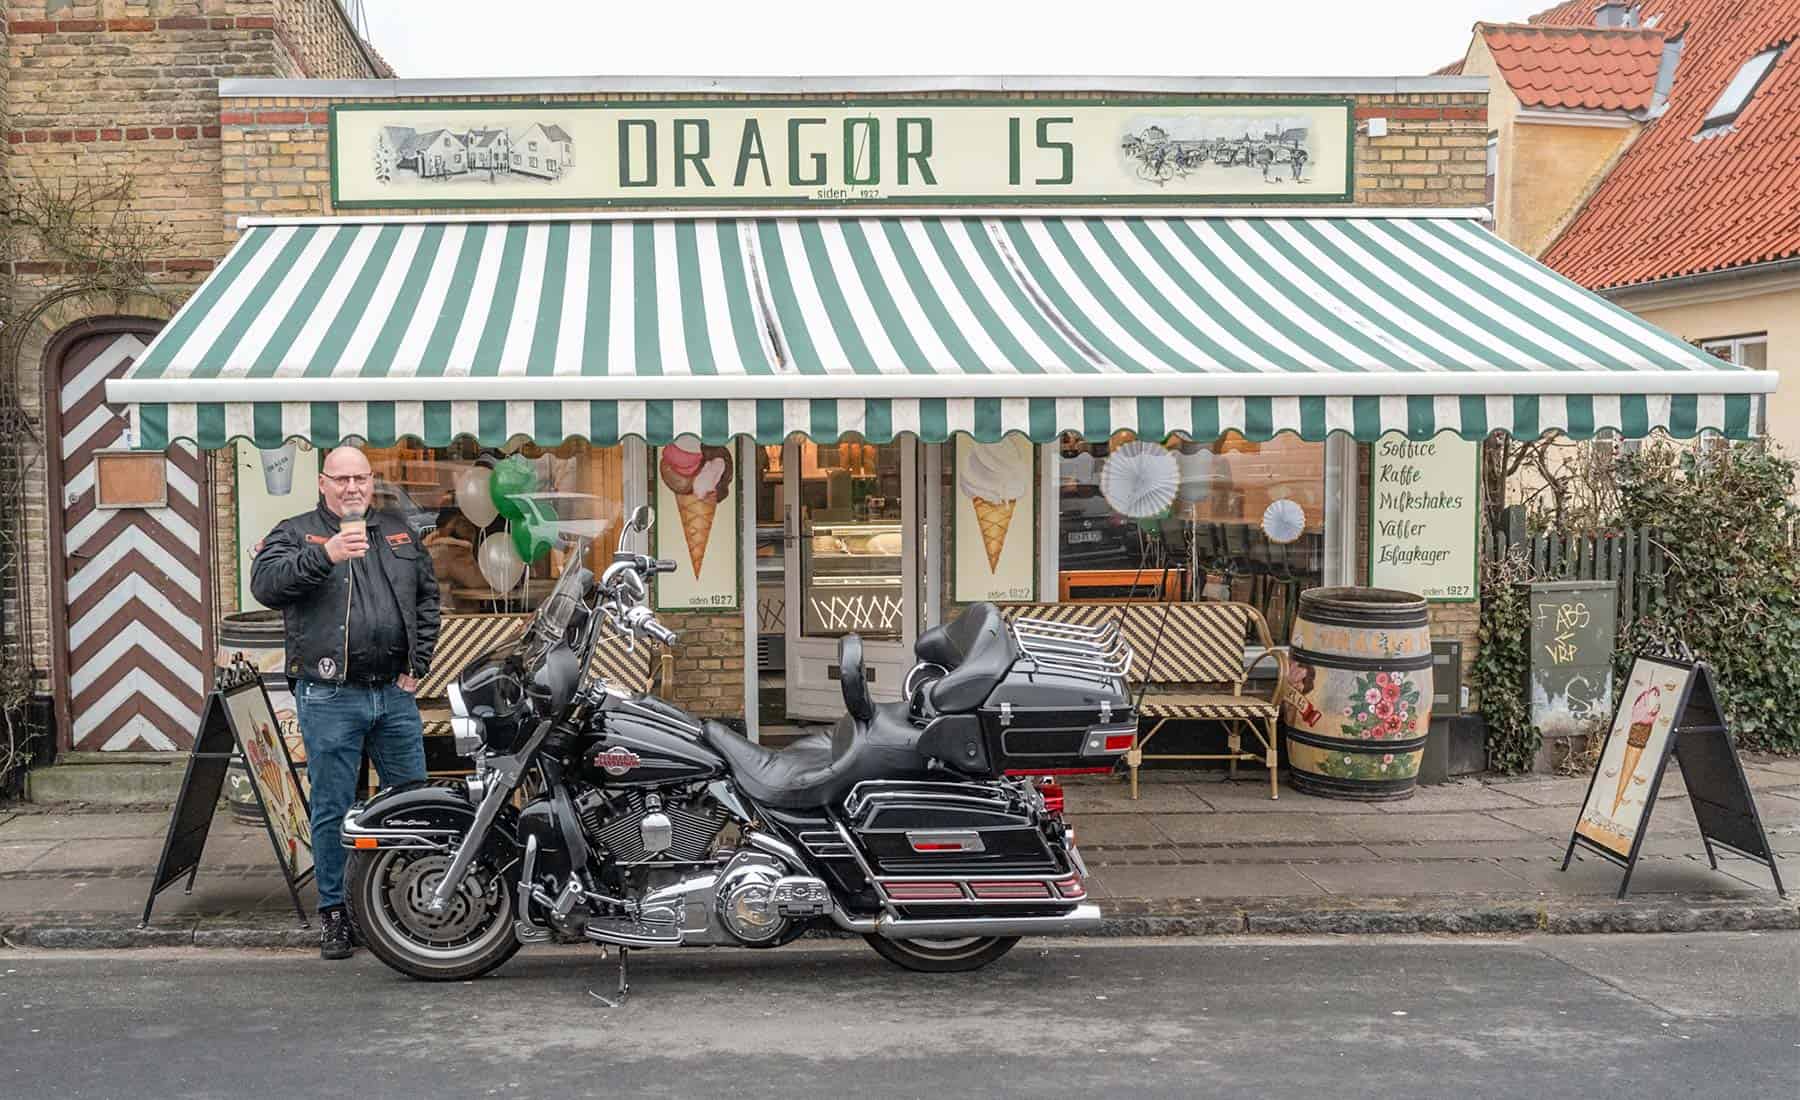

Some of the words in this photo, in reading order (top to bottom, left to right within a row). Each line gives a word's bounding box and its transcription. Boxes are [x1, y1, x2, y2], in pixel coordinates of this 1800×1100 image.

[617, 113, 938, 190] DRAGØR
[1008, 117, 1074, 185] IS
[817, 187, 847, 199] siden
[1380, 465, 1422, 485] Kaffe
[1379, 490, 1463, 513] Milkshakes
[1447, 585, 1470, 596] 1927
[711, 594, 733, 605] 1927
